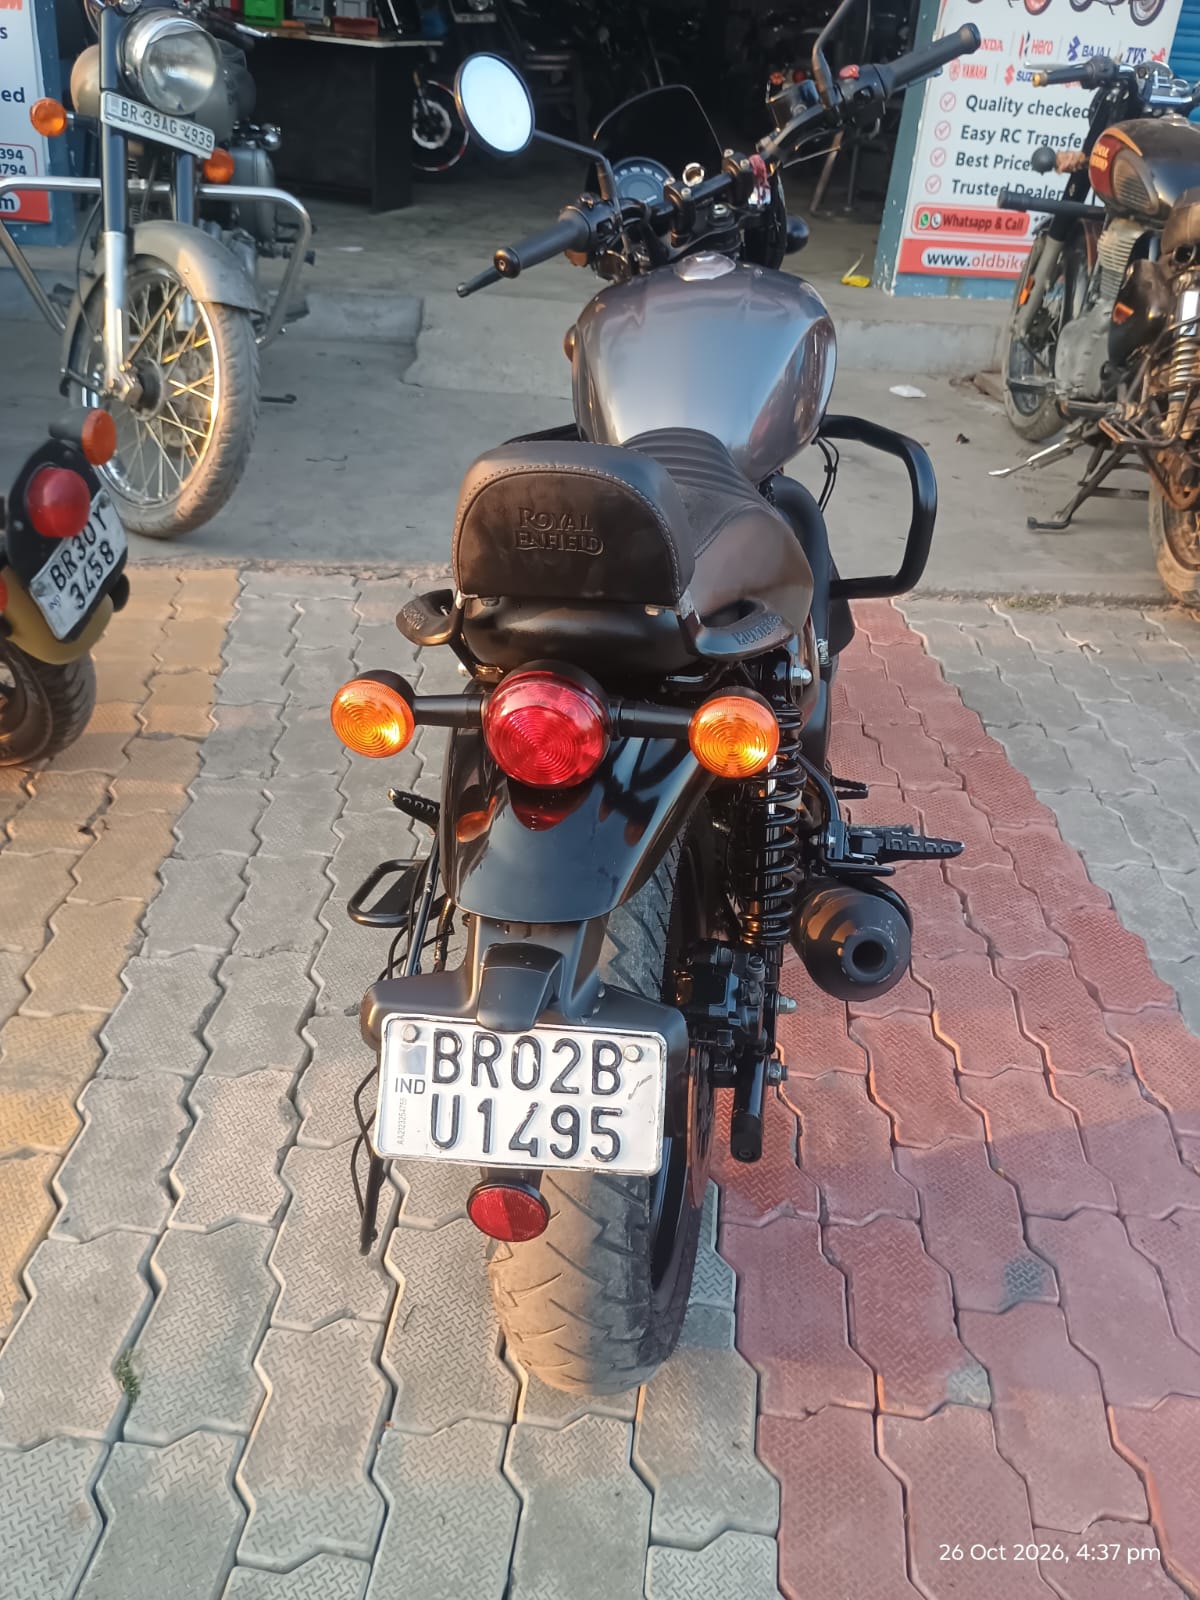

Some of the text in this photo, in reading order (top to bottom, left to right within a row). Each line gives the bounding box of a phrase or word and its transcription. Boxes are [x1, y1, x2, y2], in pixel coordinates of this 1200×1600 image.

[980, 38, 1004, 52] NDA
[1126, 46, 1147, 65] TVS
[1016, 70, 1034, 82] SUZ
[966, 94, 1023, 117] Quality
[960, 124, 1083, 149] Easy RC Transfe
[0, 163, 27, 176] 794
[955, 151, 1033, 172] Best Price
[943, 212, 992, 231] Whatsapp
[994, 216, 1002, 229] &
[1004, 216, 1025, 231] Call
[518, 506, 594, 532] ROYAL
[513, 529, 605, 556] ENFIELD
[69, 540, 116, 611] 3458
[431, 1028, 624, 1096] BR02B
[394, 1077, 426, 1094] IND
[430, 1093, 624, 1162] U1495
